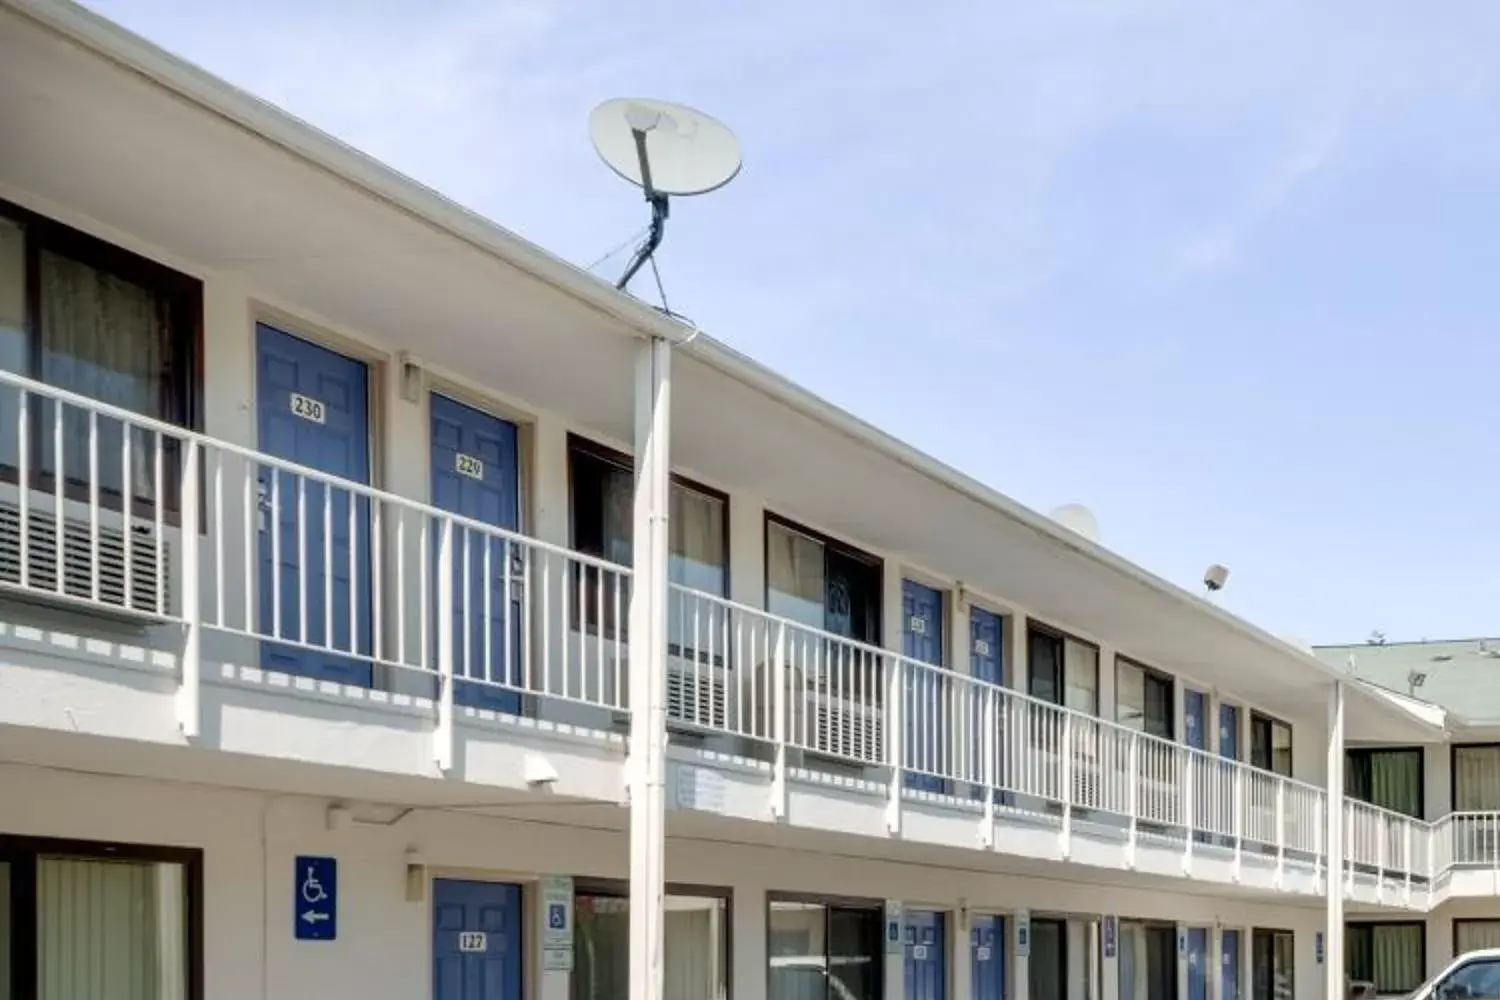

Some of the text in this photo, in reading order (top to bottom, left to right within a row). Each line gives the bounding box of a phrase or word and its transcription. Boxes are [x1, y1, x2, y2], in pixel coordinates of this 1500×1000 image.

[295, 397, 321, 419] 230
[459, 456, 481, 475] 229
[463, 934, 483, 949] 127
